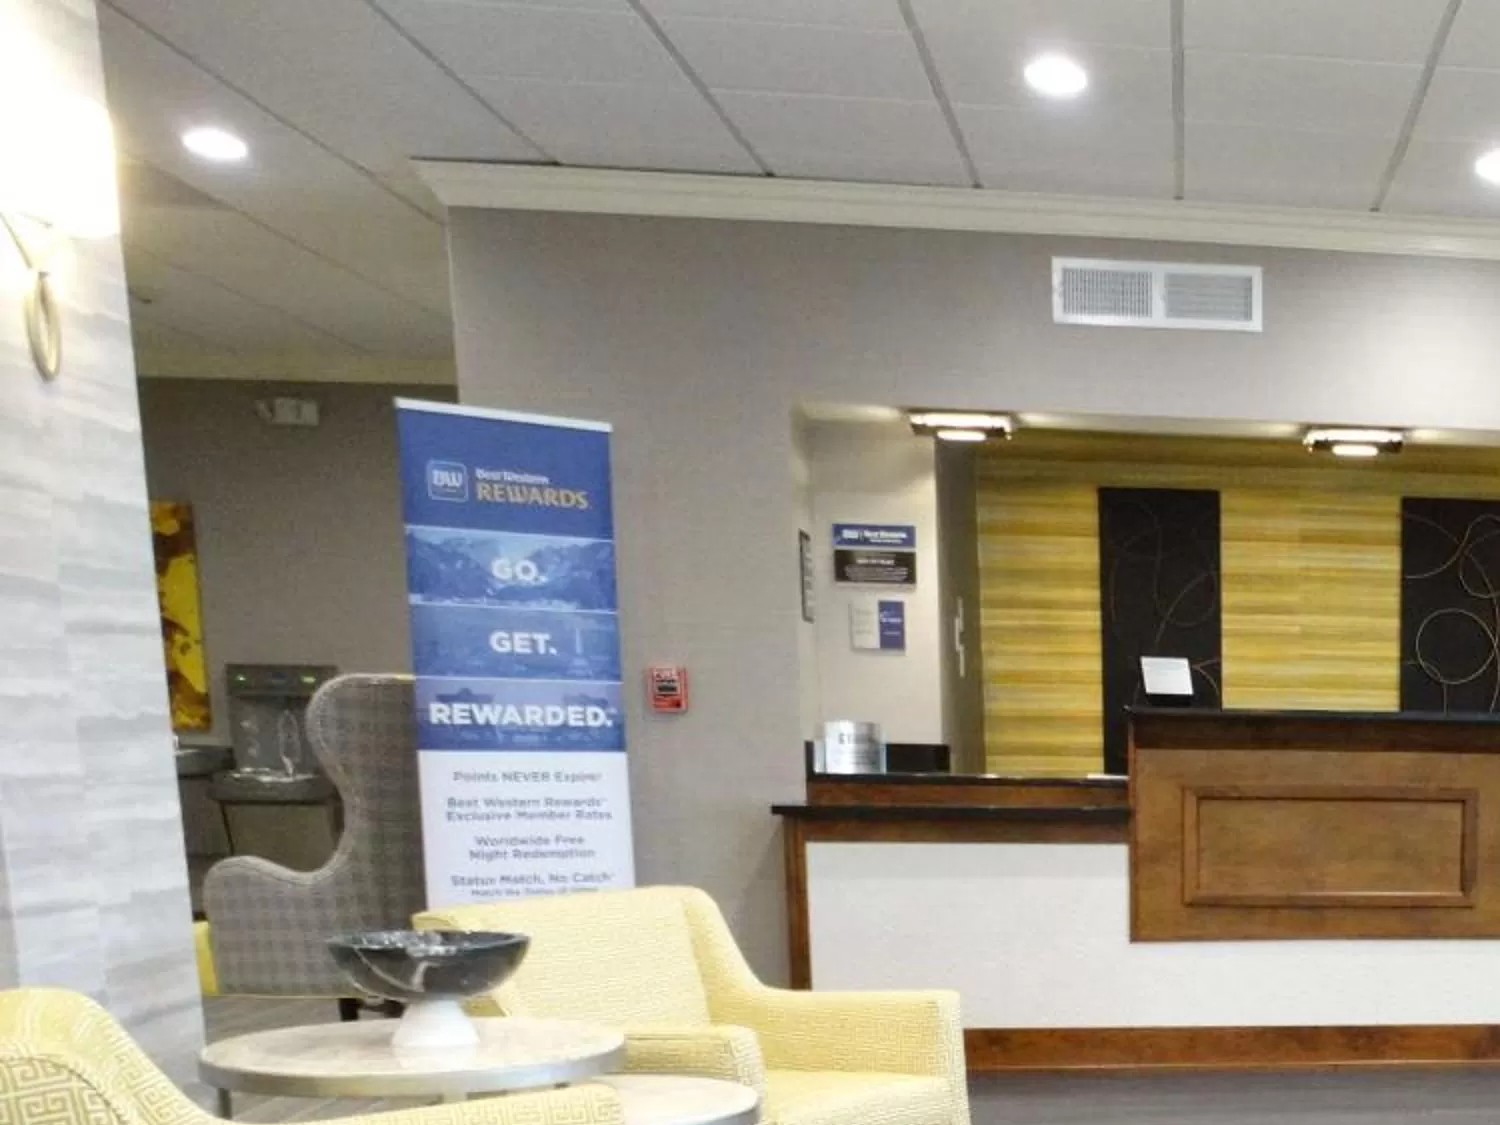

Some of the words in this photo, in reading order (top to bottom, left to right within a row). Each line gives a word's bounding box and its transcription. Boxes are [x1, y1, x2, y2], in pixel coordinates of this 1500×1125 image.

[476, 482, 589, 509] REWARDS
[491, 557, 547, 584] GO.
[489, 631, 557, 655] GET.
[452, 771, 498, 782] Points
[501, 771, 551, 782] NEVER
[483, 797, 540, 808] Western
[446, 811, 512, 822] Exclusive
[555, 835, 585, 845] Free
[469, 849, 508, 861] Night
[512, 849, 596, 859] Redemption
